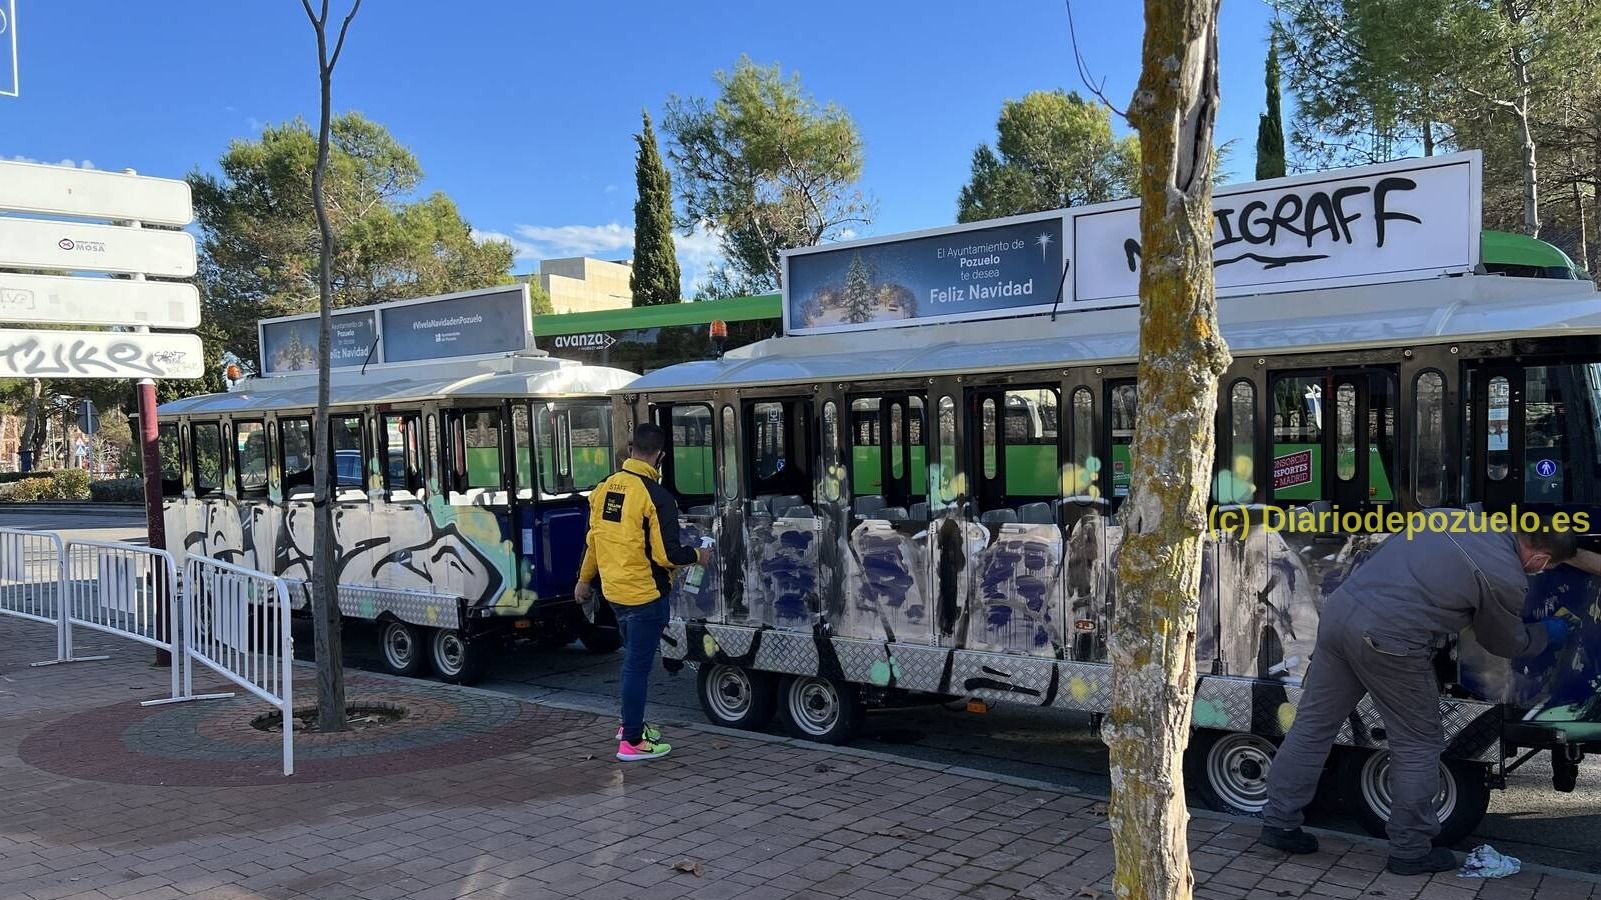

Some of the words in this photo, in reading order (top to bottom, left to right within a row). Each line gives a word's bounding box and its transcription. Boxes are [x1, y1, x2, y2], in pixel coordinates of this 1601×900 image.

[937, 248, 945, 258] El
[947, 241, 1009, 259] Ayuntamiento
[1011, 239, 1025, 249] de
[960, 254, 1000, 268] Pozuelo
[960, 270, 970, 281] te
[972, 268, 1000, 280] desea
[930, 286, 964, 304] Feliz
[969, 278, 1033, 300] Navidad
[555, 333, 603, 348] avanza
[342, 345, 369, 358] Navidad
[1280, 472, 1308, 486] MADRID
